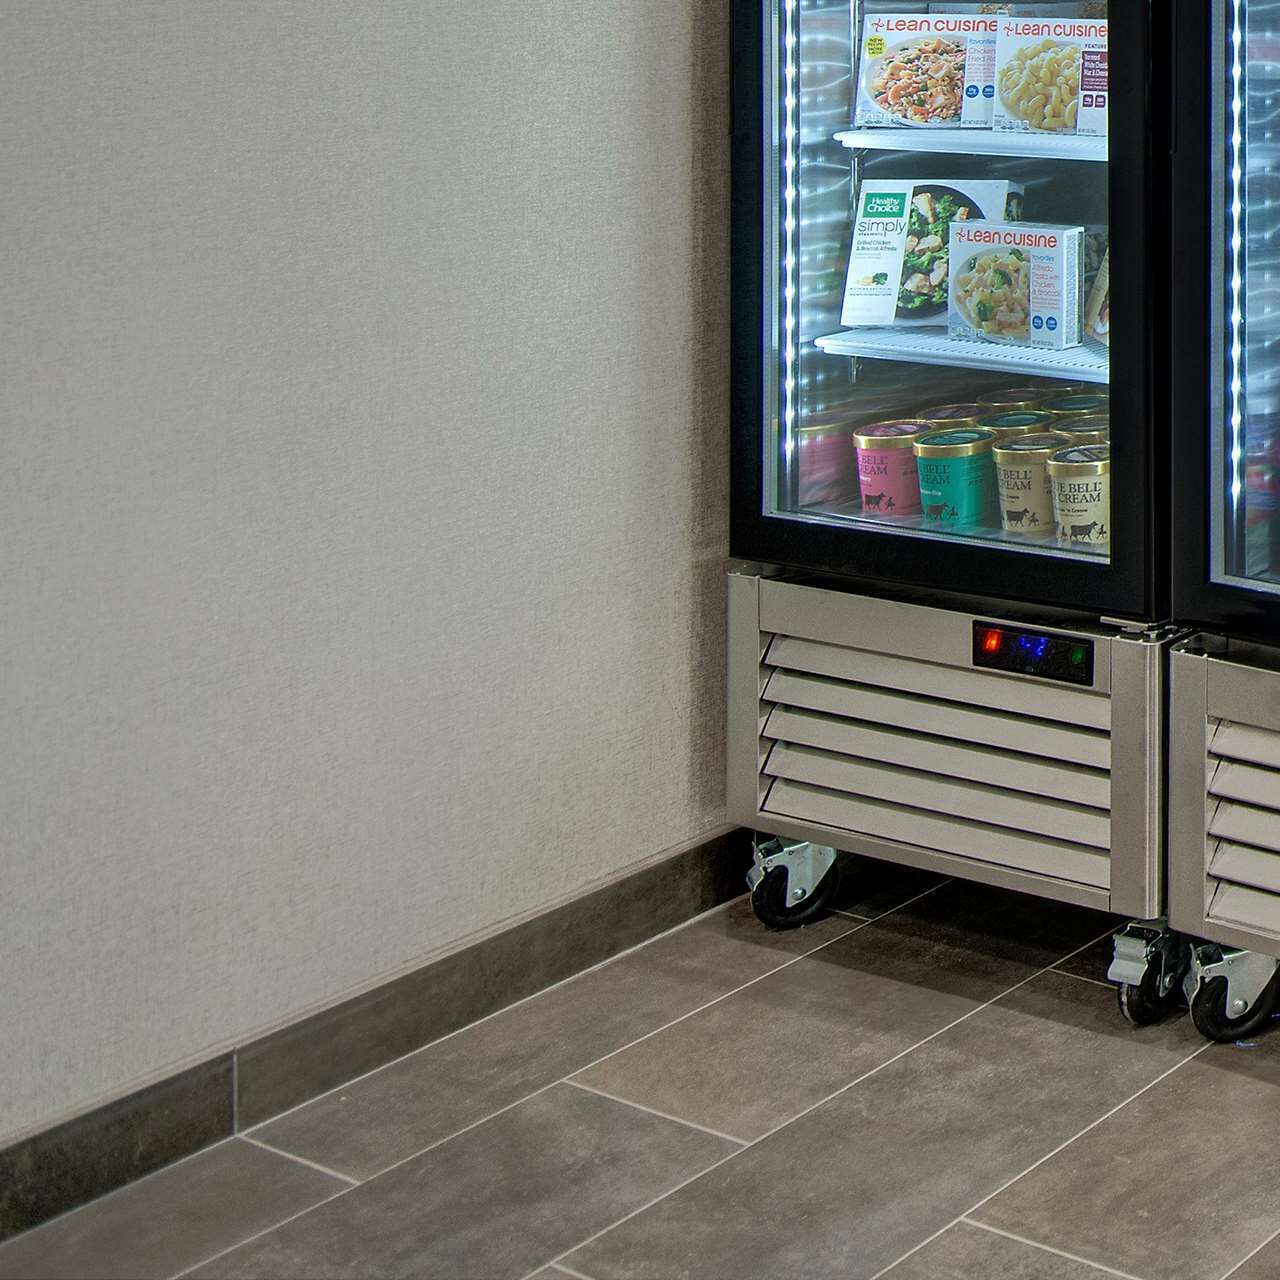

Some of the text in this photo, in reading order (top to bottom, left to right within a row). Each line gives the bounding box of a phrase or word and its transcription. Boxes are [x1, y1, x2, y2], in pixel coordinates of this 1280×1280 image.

[886, 19, 930, 32] Lean
[1014, 23, 1050, 35] Lean
[871, 197, 900, 206] Healthy
[867, 203, 900, 212] Choice
[858, 219, 907, 237] simply
[967, 229, 1000, 244] Lean
[1069, 482, 1101, 493] BELL
[1058, 493, 1101, 503] CREAM
